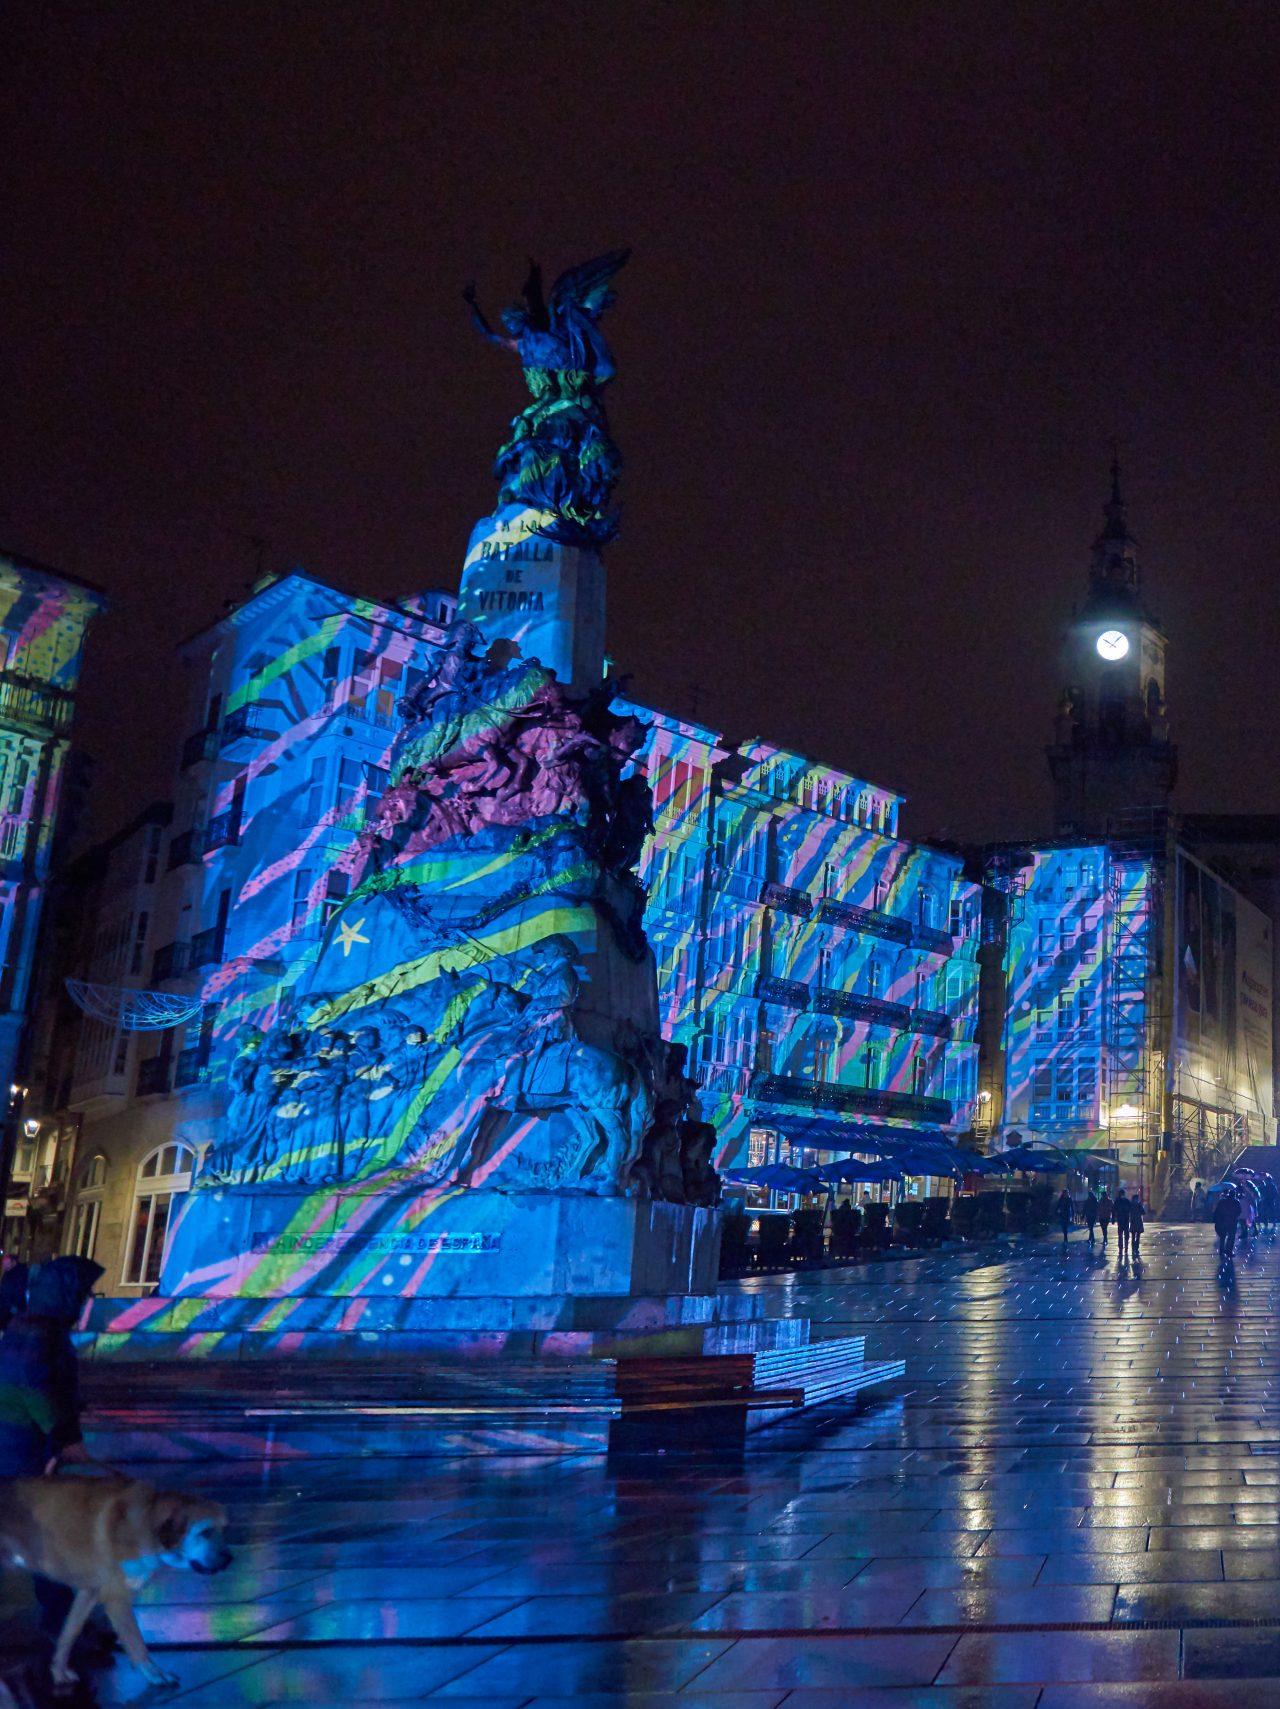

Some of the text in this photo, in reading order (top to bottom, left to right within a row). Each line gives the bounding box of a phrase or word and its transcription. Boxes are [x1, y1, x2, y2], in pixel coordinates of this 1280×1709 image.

[501, 520, 539, 532] A LA
[481, 541, 554, 561] BATALLA
[505, 569, 523, 583] DE
[479, 591, 544, 611] VITORIA
